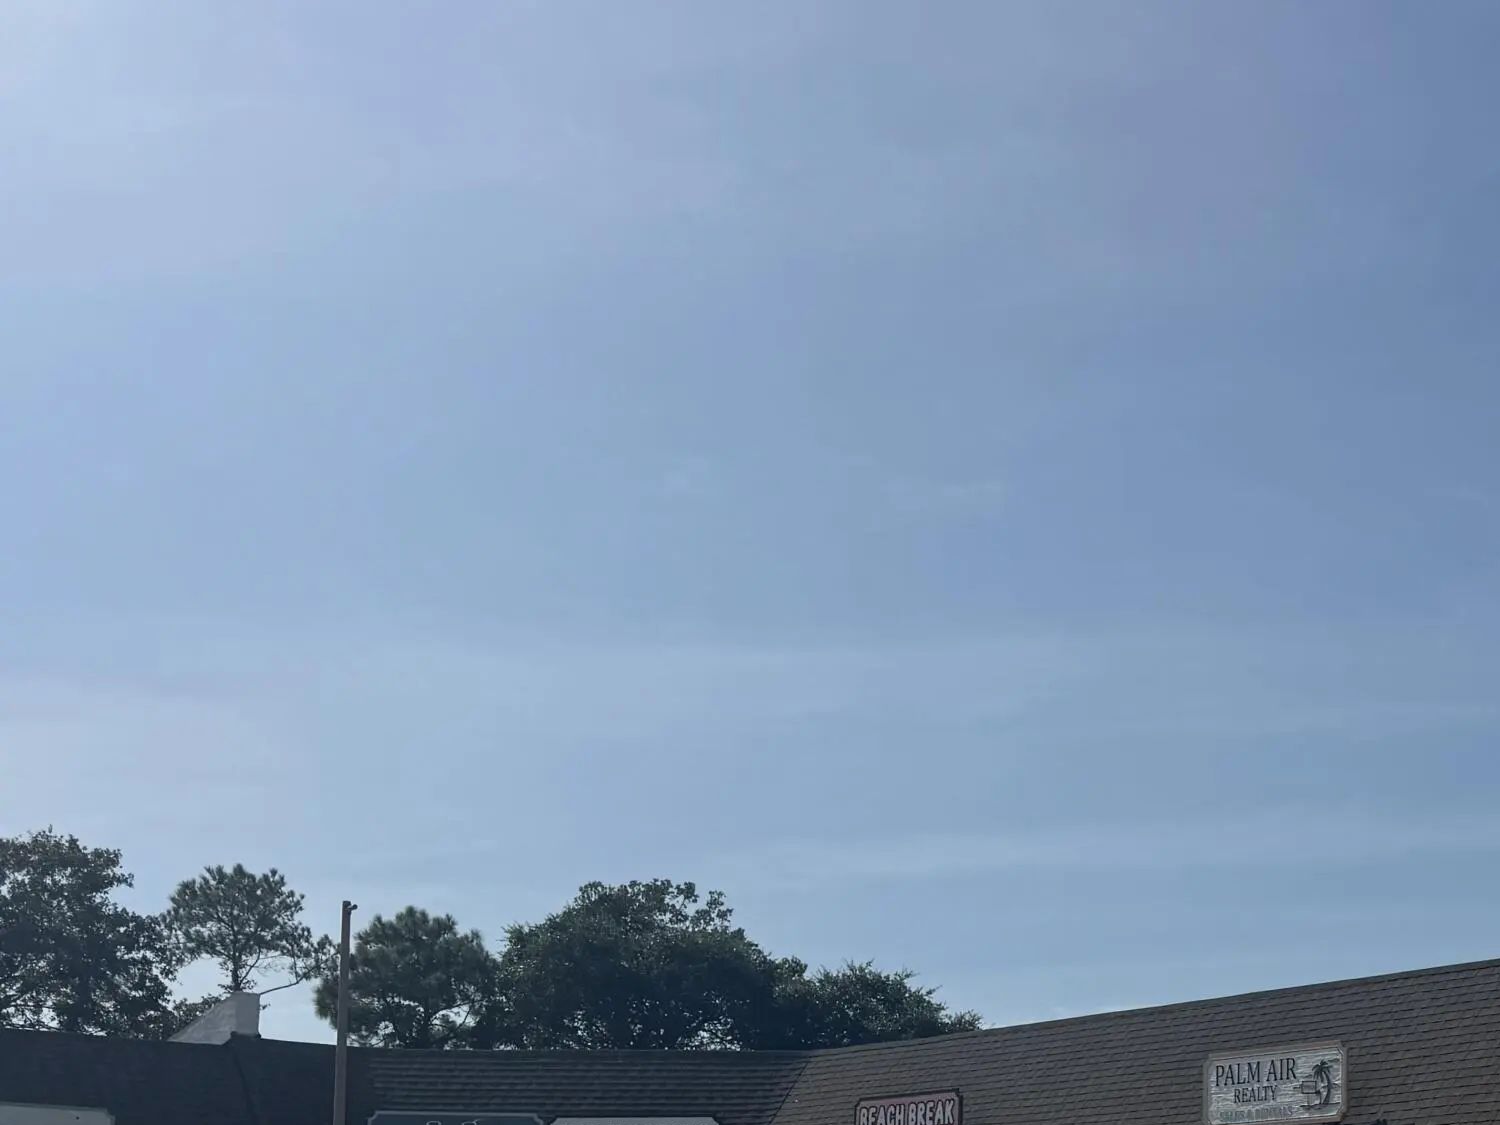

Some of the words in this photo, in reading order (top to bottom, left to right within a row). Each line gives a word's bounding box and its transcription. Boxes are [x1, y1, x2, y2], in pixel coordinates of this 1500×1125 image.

[1215, 1061, 1261, 1087] PALM
[1266, 1057, 1297, 1082] AIR
[1233, 1085, 1278, 1103] REALTY
